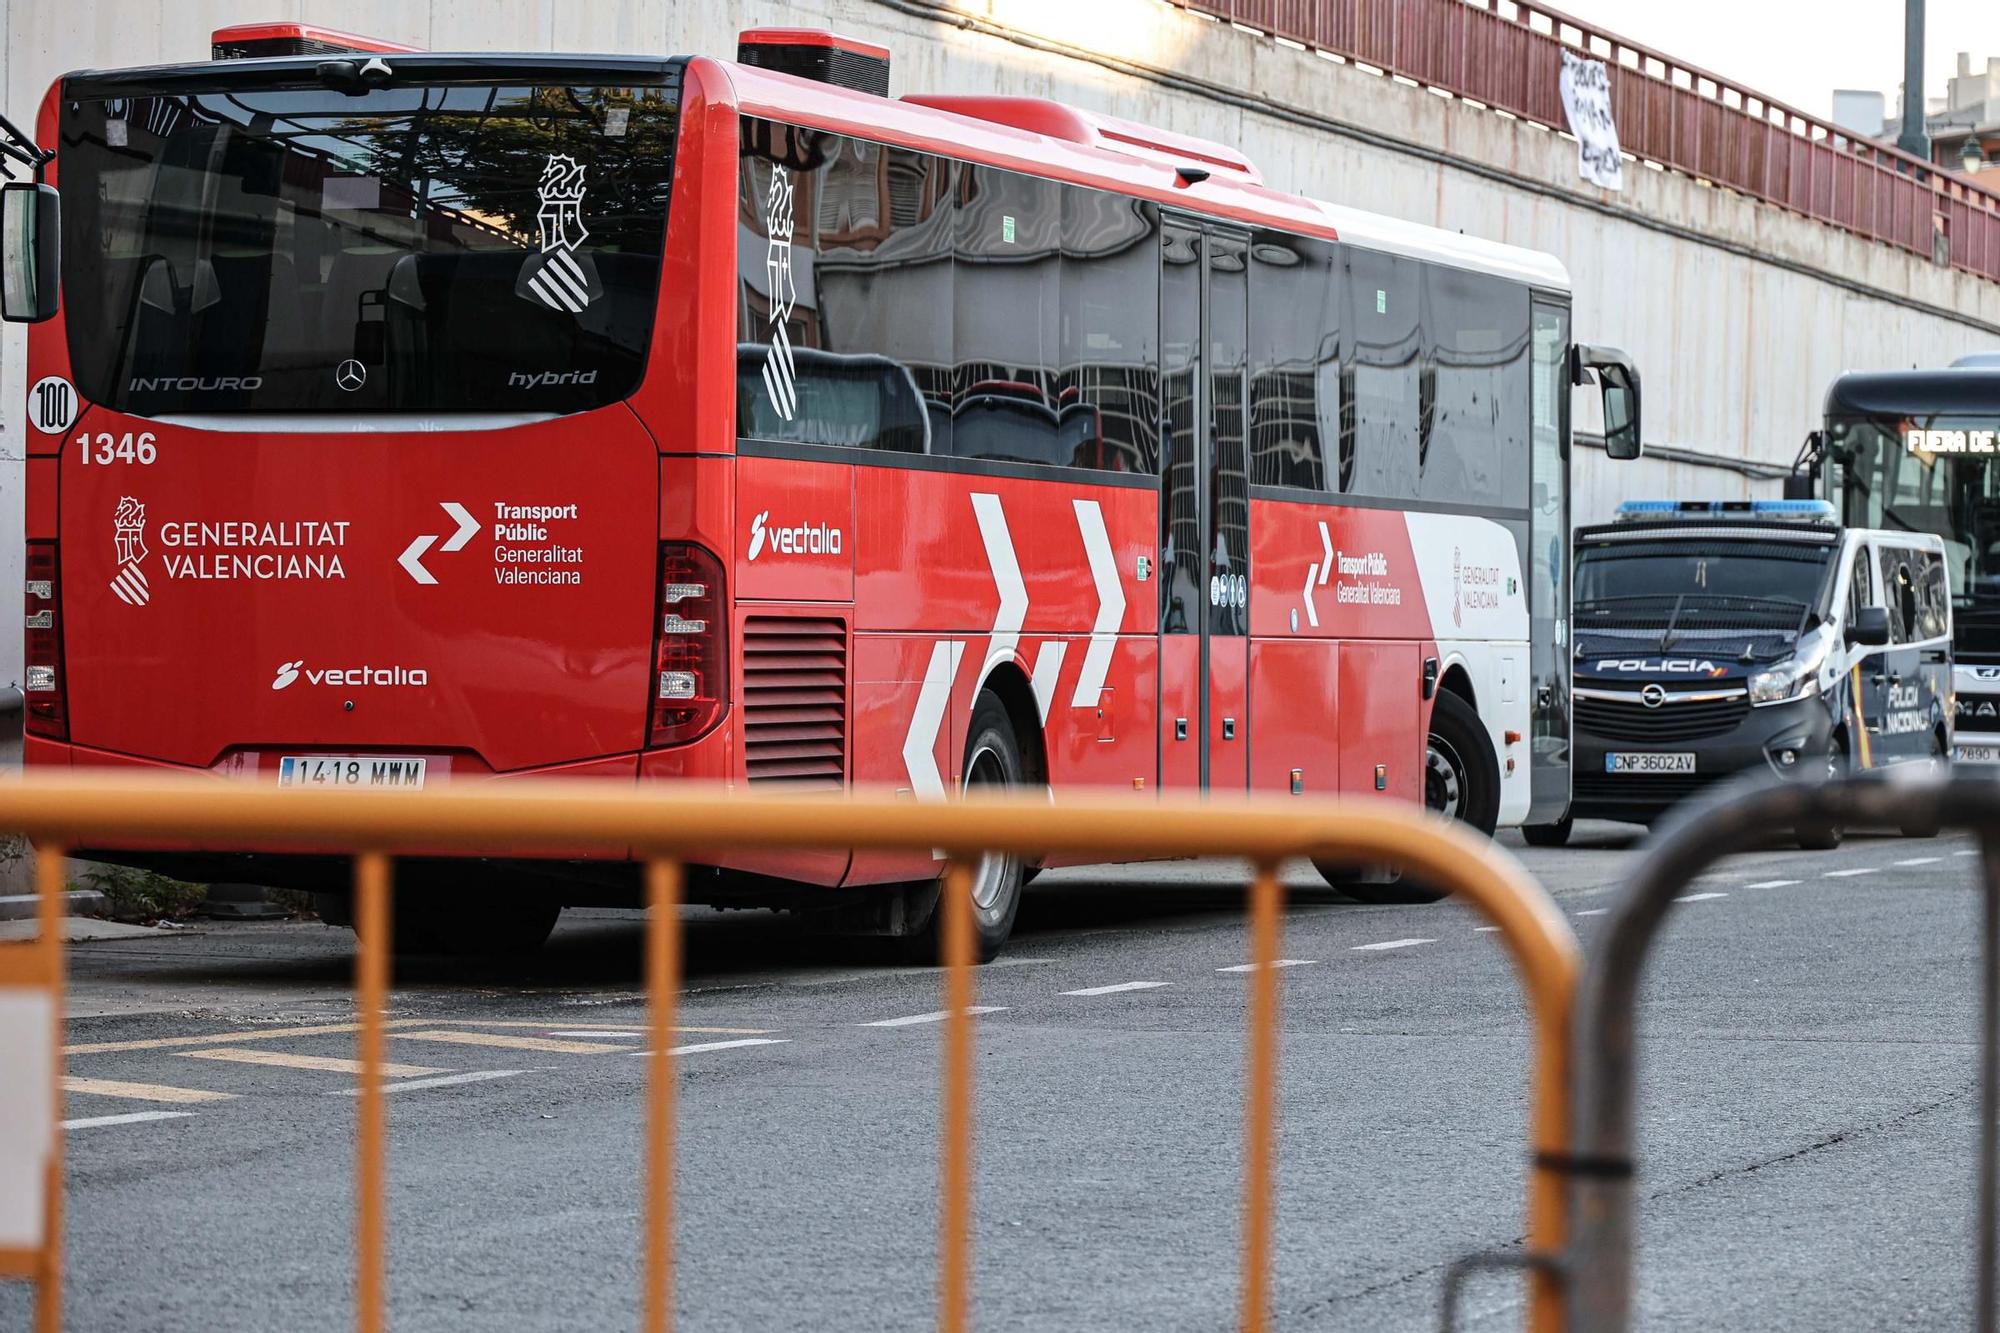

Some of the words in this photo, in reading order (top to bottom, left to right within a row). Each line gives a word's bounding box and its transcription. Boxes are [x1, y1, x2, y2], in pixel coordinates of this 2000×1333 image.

[129, 377, 262, 391] INTOURO
[508, 370, 597, 390] hybrid
[36, 383, 69, 428] 100
[76, 432, 157, 465] 1346
[1908, 430, 1966, 452] FUERA
[1969, 430, 1995, 452] DE
[495, 502, 577, 523] Transport
[160, 521, 350, 546] GENERALITAT
[495, 523, 548, 541] Públic
[768, 520, 841, 554] vectalia
[495, 544, 583, 563] Generalitat
[162, 554, 346, 579] VALENCIANA
[495, 566, 581, 584] Valenciana
[1337, 551, 1367, 579] Transport
[1337, 580, 1369, 604] Generalitat
[1369, 581, 1400, 605] Valenciana
[306, 665, 428, 686] vectalia
[1954, 701, 2000, 716] MA
[300, 760, 360, 785] 1418
[370, 762, 420, 786] MWM
[1614, 755, 1693, 770] CNP3602AV
